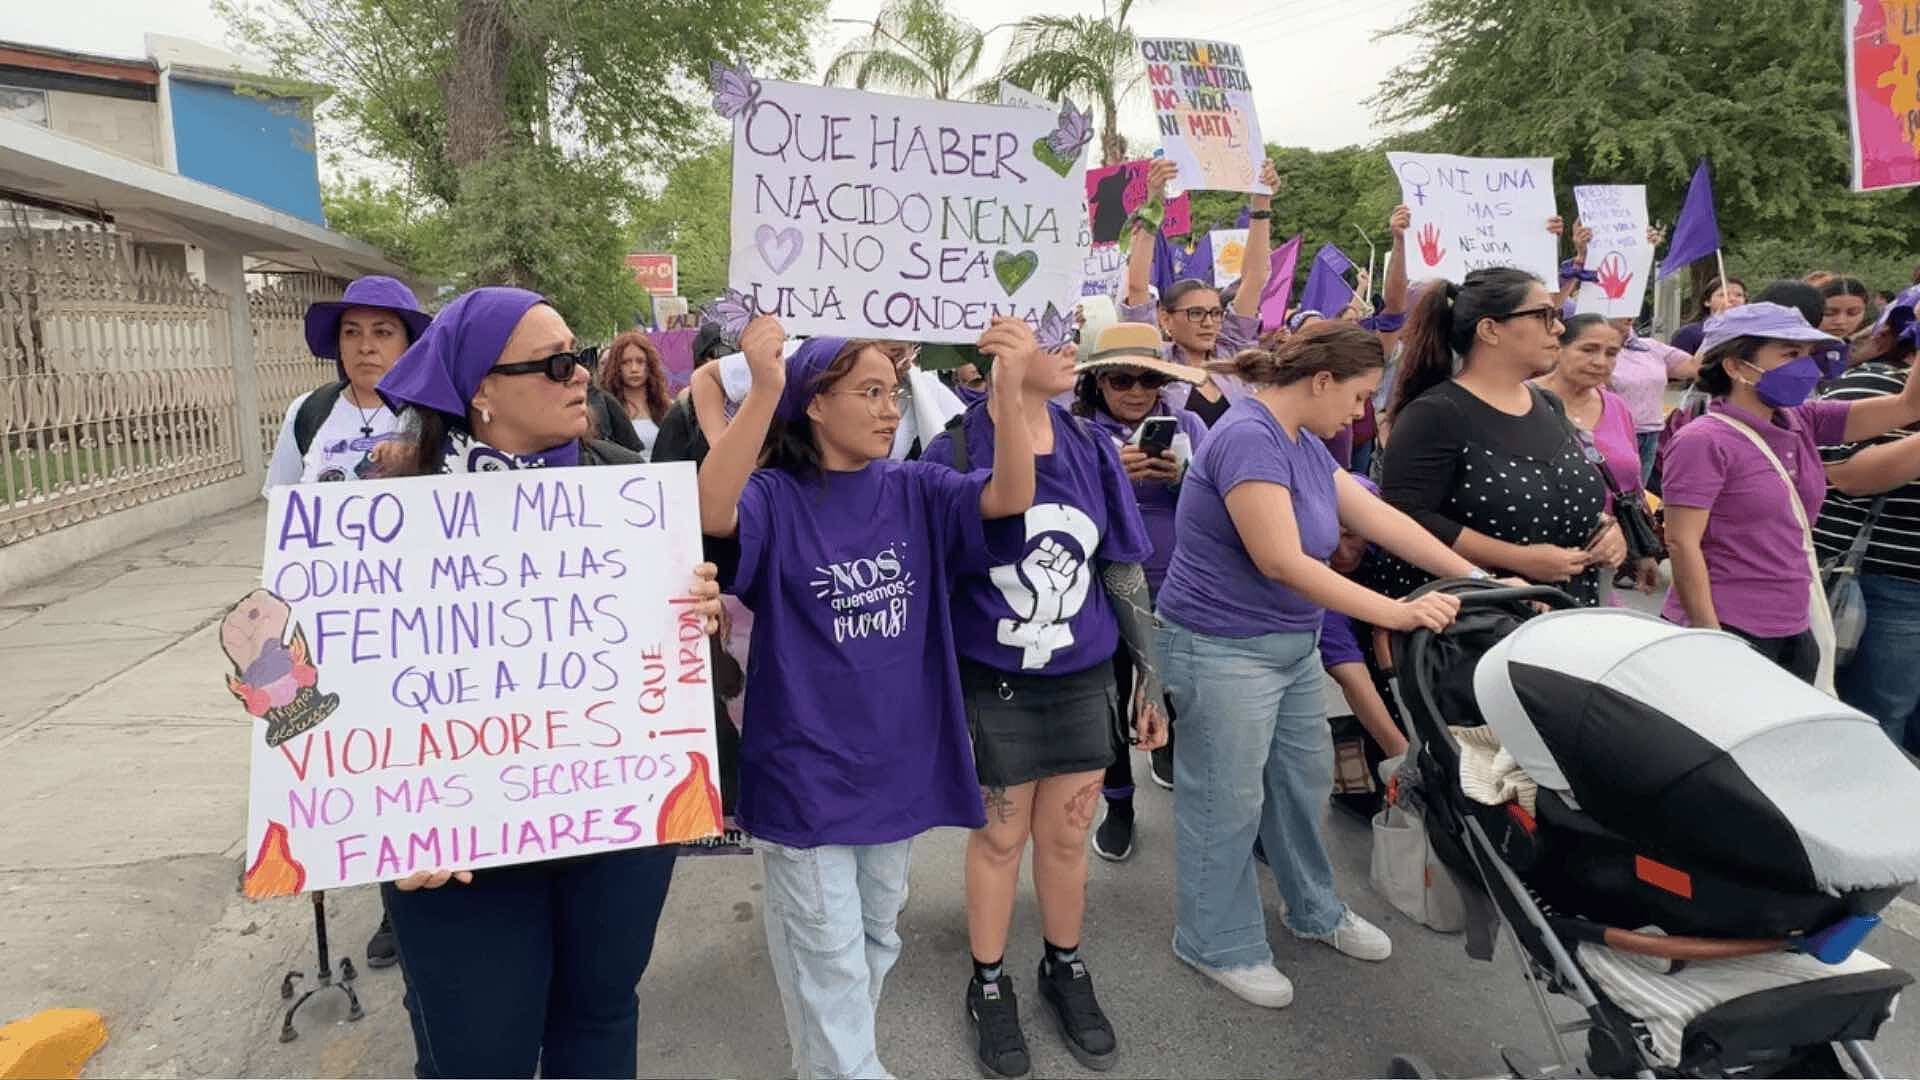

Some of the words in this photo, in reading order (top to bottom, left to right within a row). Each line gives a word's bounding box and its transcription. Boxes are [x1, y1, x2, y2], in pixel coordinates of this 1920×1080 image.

[1141, 40, 1196, 61] QUIEN
[1207, 43, 1244, 66] AMA
[1148, 64, 1173, 85] NO
[1181, 64, 1252, 92] MALTRATA
[1153, 88, 1180, 110] NO
[1185, 89, 1231, 113] VIOLA
[745, 100, 855, 162] QUE
[870, 115, 1027, 183] HABER
[1158, 115, 1180, 136] NI
[1187, 115, 1232, 137] MATA
[1436, 167, 1473, 195] NI
[1486, 167, 1536, 192] UNA
[754, 174, 932, 233] NACIDO
[941, 196, 1061, 244] NENA
[1465, 202, 1513, 219] MAS
[817, 232, 884, 272] NO
[899, 241, 989, 283] SEA
[751, 283, 846, 319] UNA
[278, 491, 404, 551] ALGO
[432, 489, 480, 540] VA
[512, 480, 602, 532] MAL
[620, 476, 666, 530] SI
[275, 559, 403, 603] ODIAN
[430, 554, 508, 590] MAS
[519, 552, 543, 588] A
[557, 547, 627, 579] LAS
[829, 549, 901, 595] NOS
[831, 582, 905, 611] queremos
[834, 598, 907, 643] vivas!
[315, 593, 628, 665] FEMINISTAS
[392, 665, 485, 714] QUE
[494, 660, 520, 699] A
[537, 650, 619, 691] LOS
[279, 701, 621, 781] VIOLADORES
[287, 787, 354, 829] NO
[375, 773, 473, 816] MAS
[500, 754, 677, 802] SECRETOS
[336, 804, 643, 881] FAMILIARES
